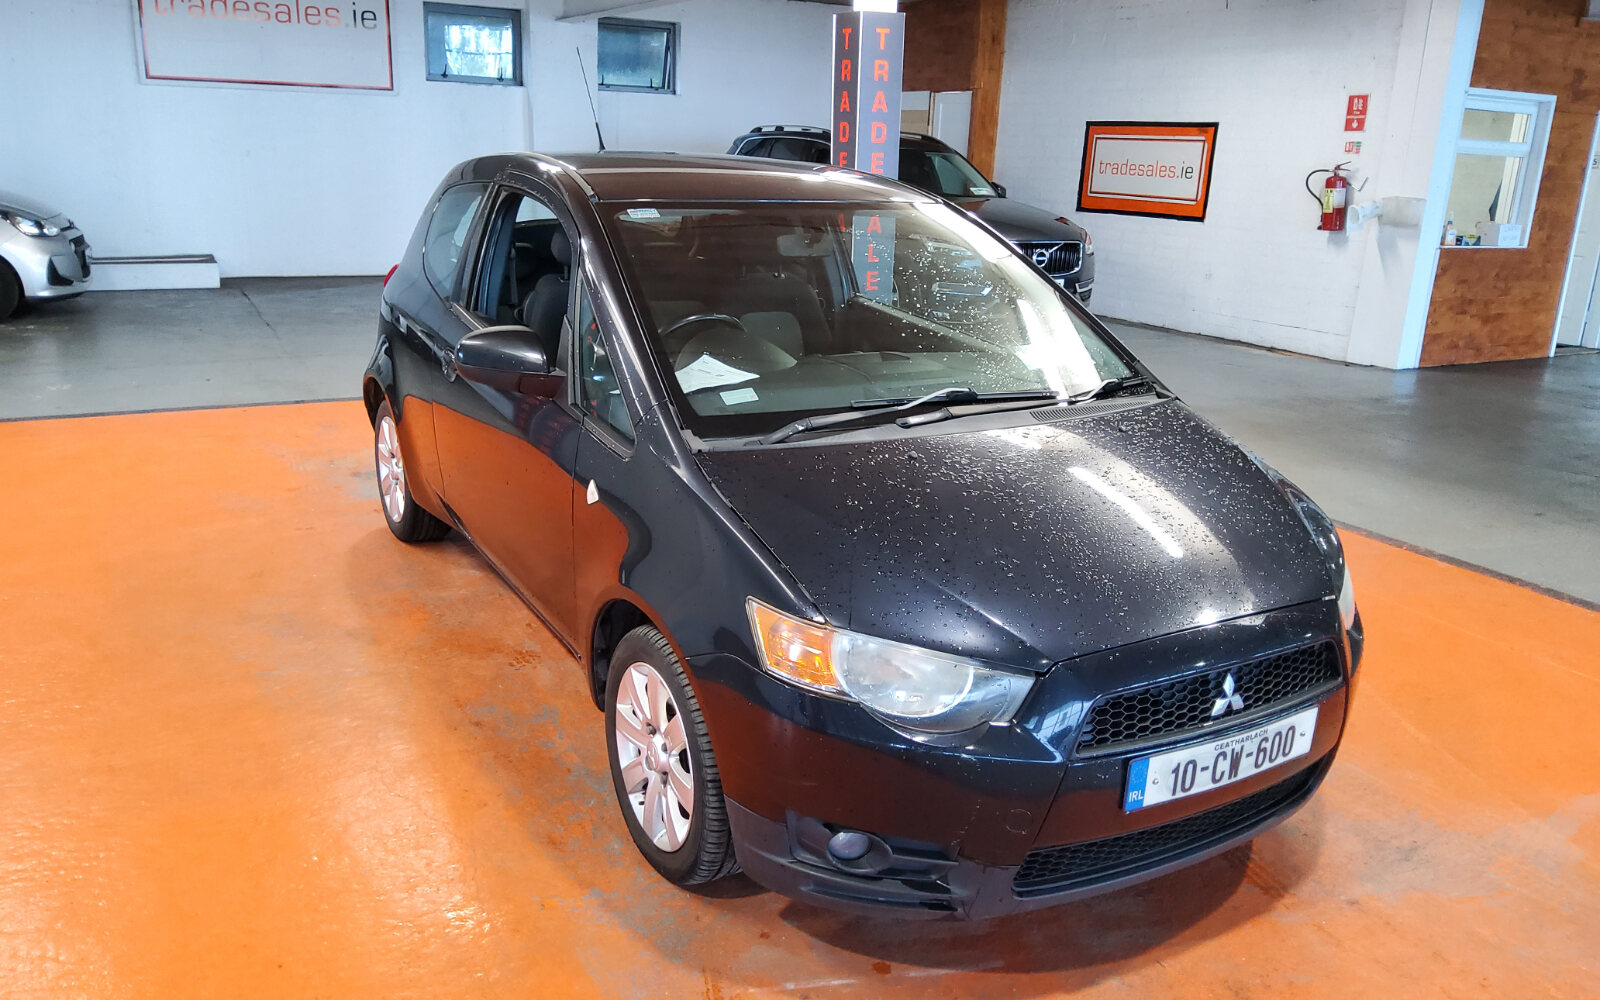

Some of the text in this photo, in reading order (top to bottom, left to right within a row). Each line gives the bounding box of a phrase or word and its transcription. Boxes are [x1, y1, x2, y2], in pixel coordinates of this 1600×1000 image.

[154, 0, 378, 30] tradesales.ie
[839, 27, 852, 169] TRADE
[866, 27, 891, 291] TRADE ALE
[1098, 158, 1194, 179] tradesales.ie
[1214, 728, 1269, 751] CEATHARLACH
[1171, 725, 1296, 797] 10-CW-600
[1128, 790, 1144, 803] IRL
